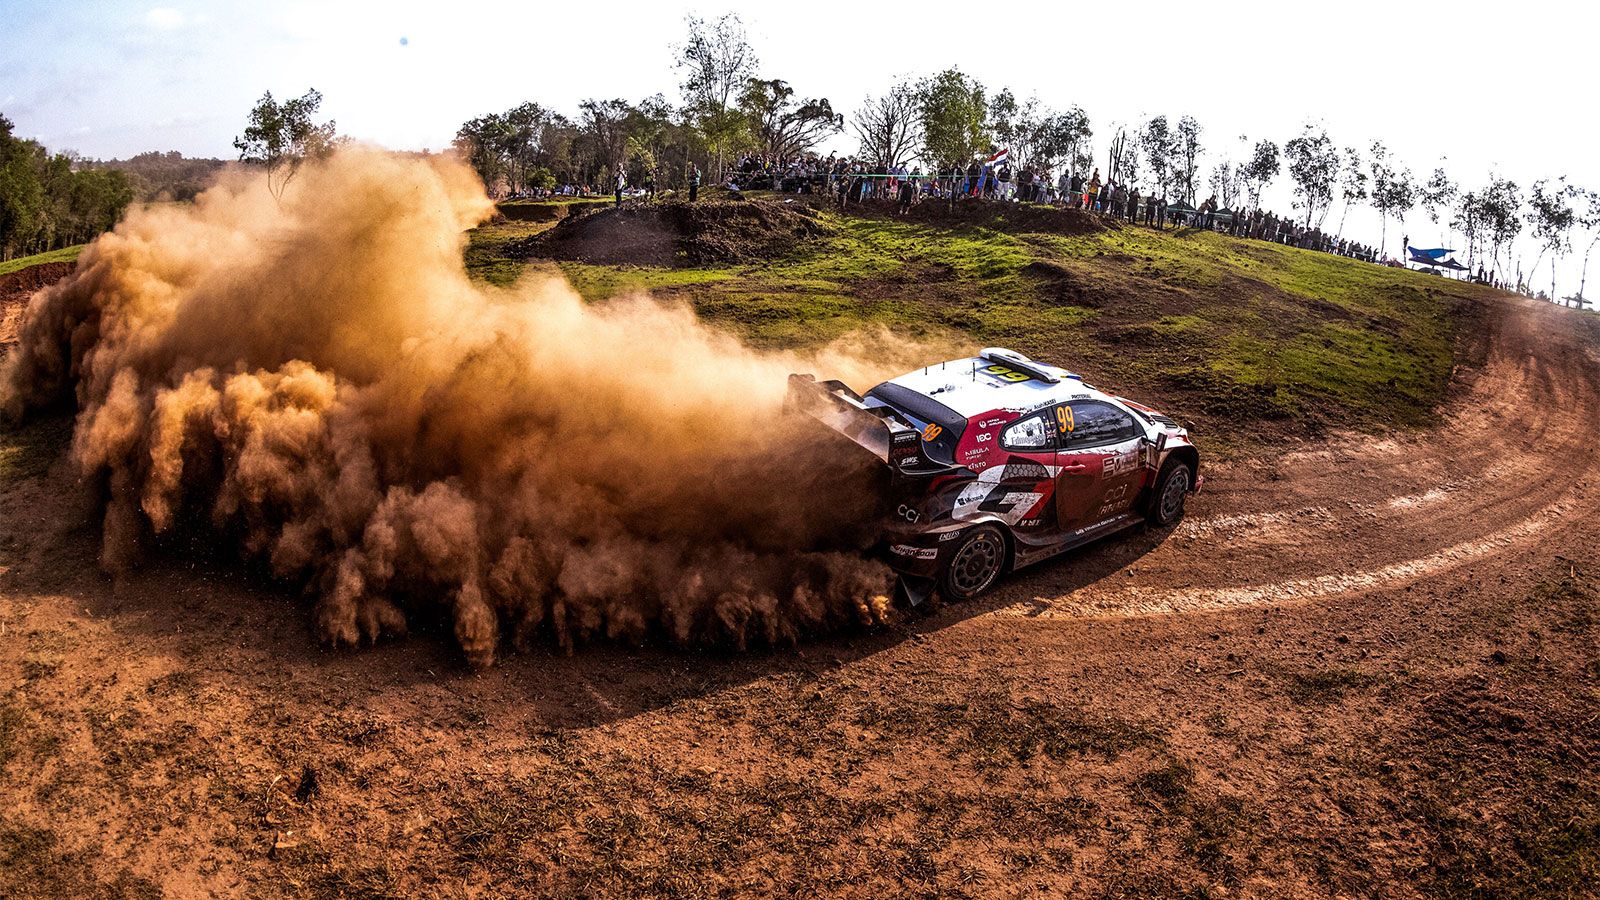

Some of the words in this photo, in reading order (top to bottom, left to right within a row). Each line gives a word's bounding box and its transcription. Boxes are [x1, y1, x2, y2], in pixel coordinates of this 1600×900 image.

[1056, 405, 1075, 433] 99
[921, 423, 943, 442] 99
[965, 494, 984, 503] Microsoft
